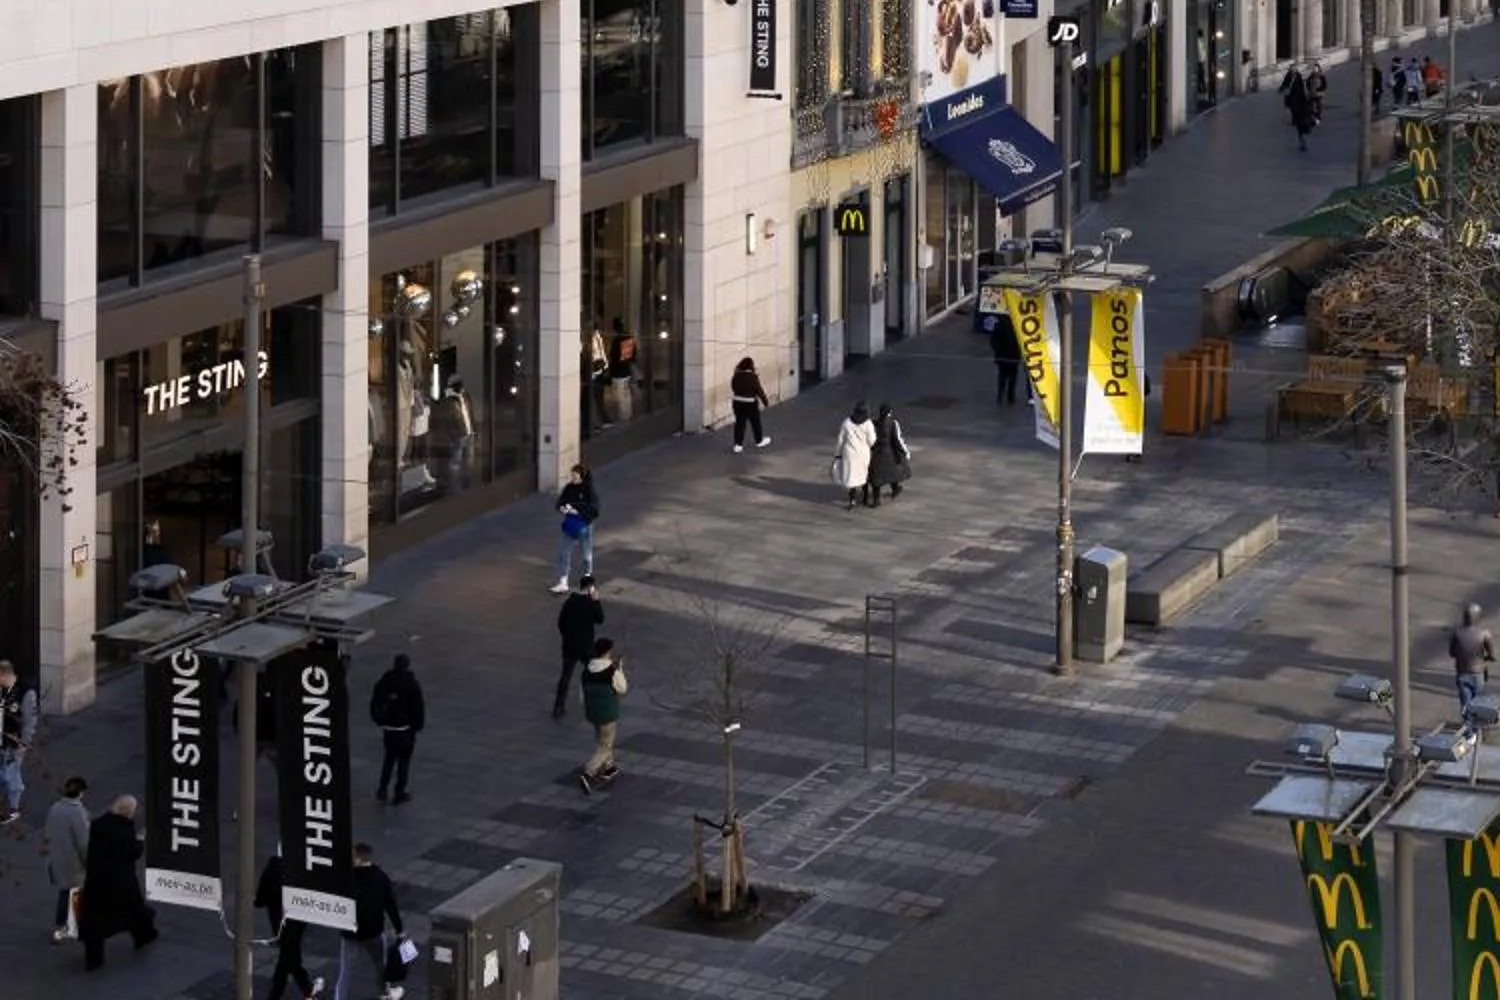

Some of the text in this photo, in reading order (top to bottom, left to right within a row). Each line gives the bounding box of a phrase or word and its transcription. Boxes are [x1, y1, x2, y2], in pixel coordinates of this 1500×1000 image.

[757, 21, 769, 69] STING
[1052, 23, 1079, 42] JD
[1104, 298, 1129, 397] Panos
[143, 374, 191, 416] THE
[171, 647, 201, 852] THE STING
[301, 664, 333, 871] THE STING
